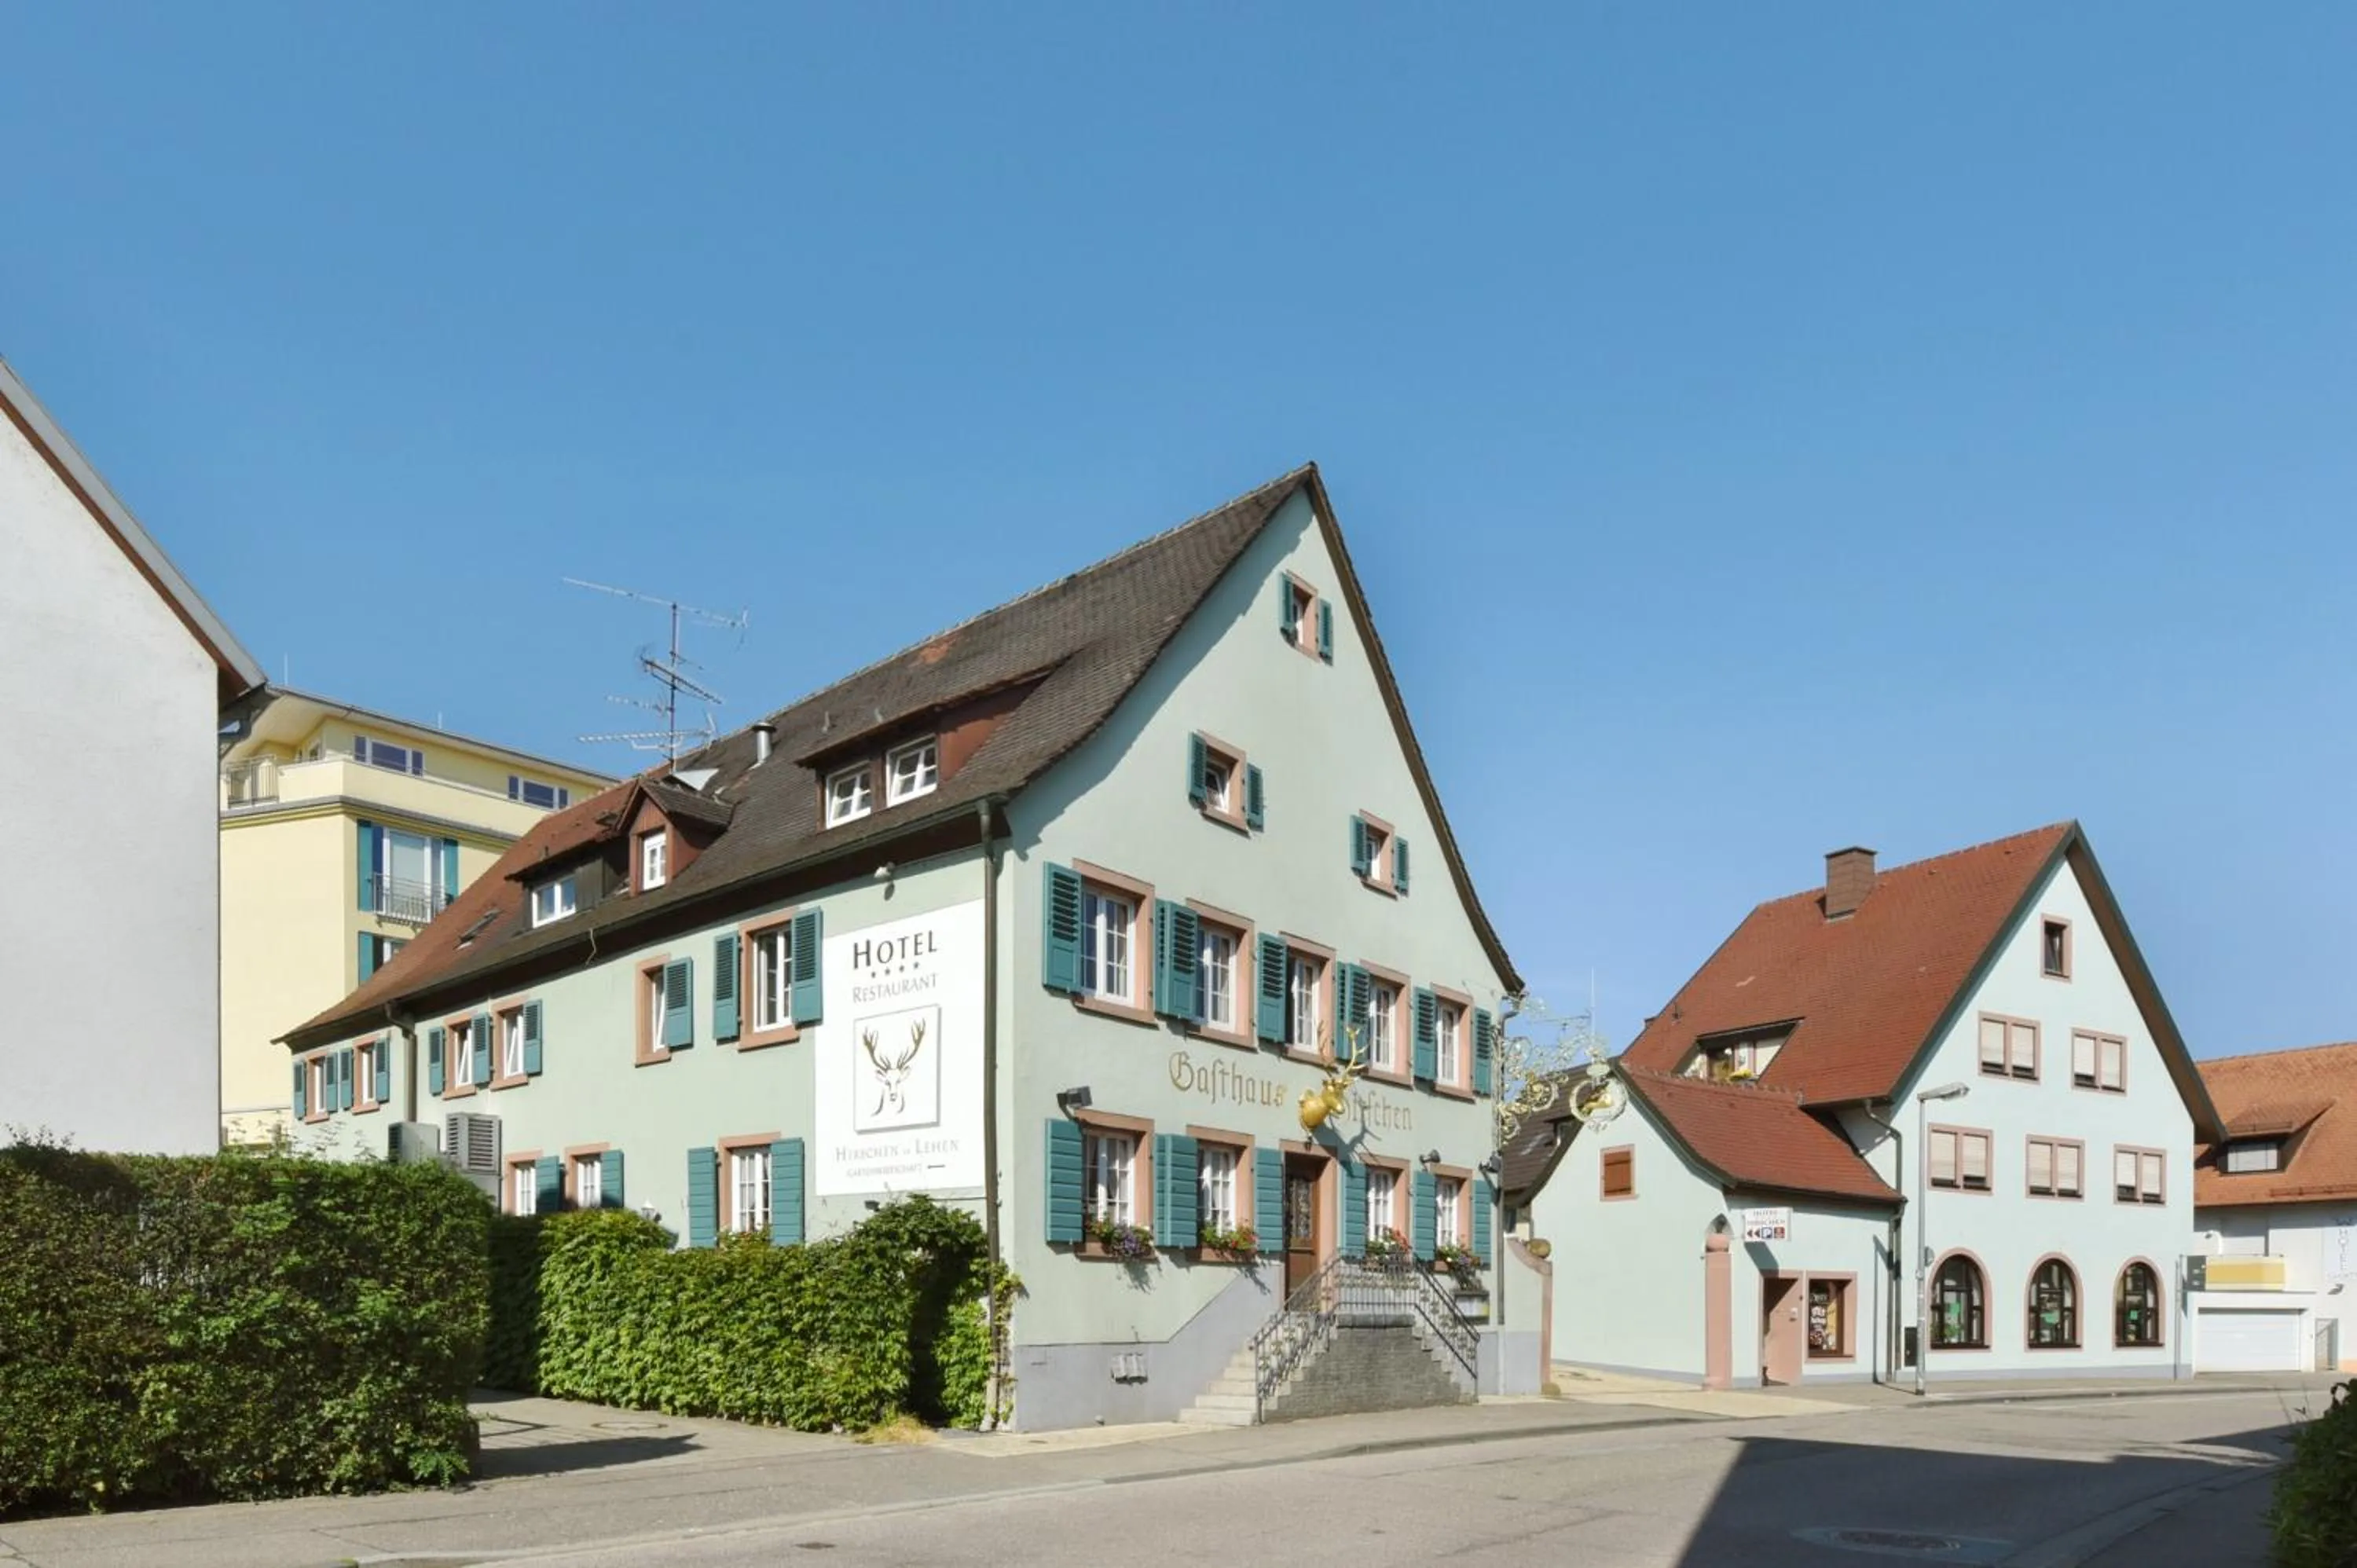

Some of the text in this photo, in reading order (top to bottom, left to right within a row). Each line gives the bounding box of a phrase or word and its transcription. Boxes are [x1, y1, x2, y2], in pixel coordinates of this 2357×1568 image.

[853, 930, 938, 969] HOTEL
[852, 973, 939, 1003] RESTAURANT
[915, 1138, 960, 1156] LEHEN
